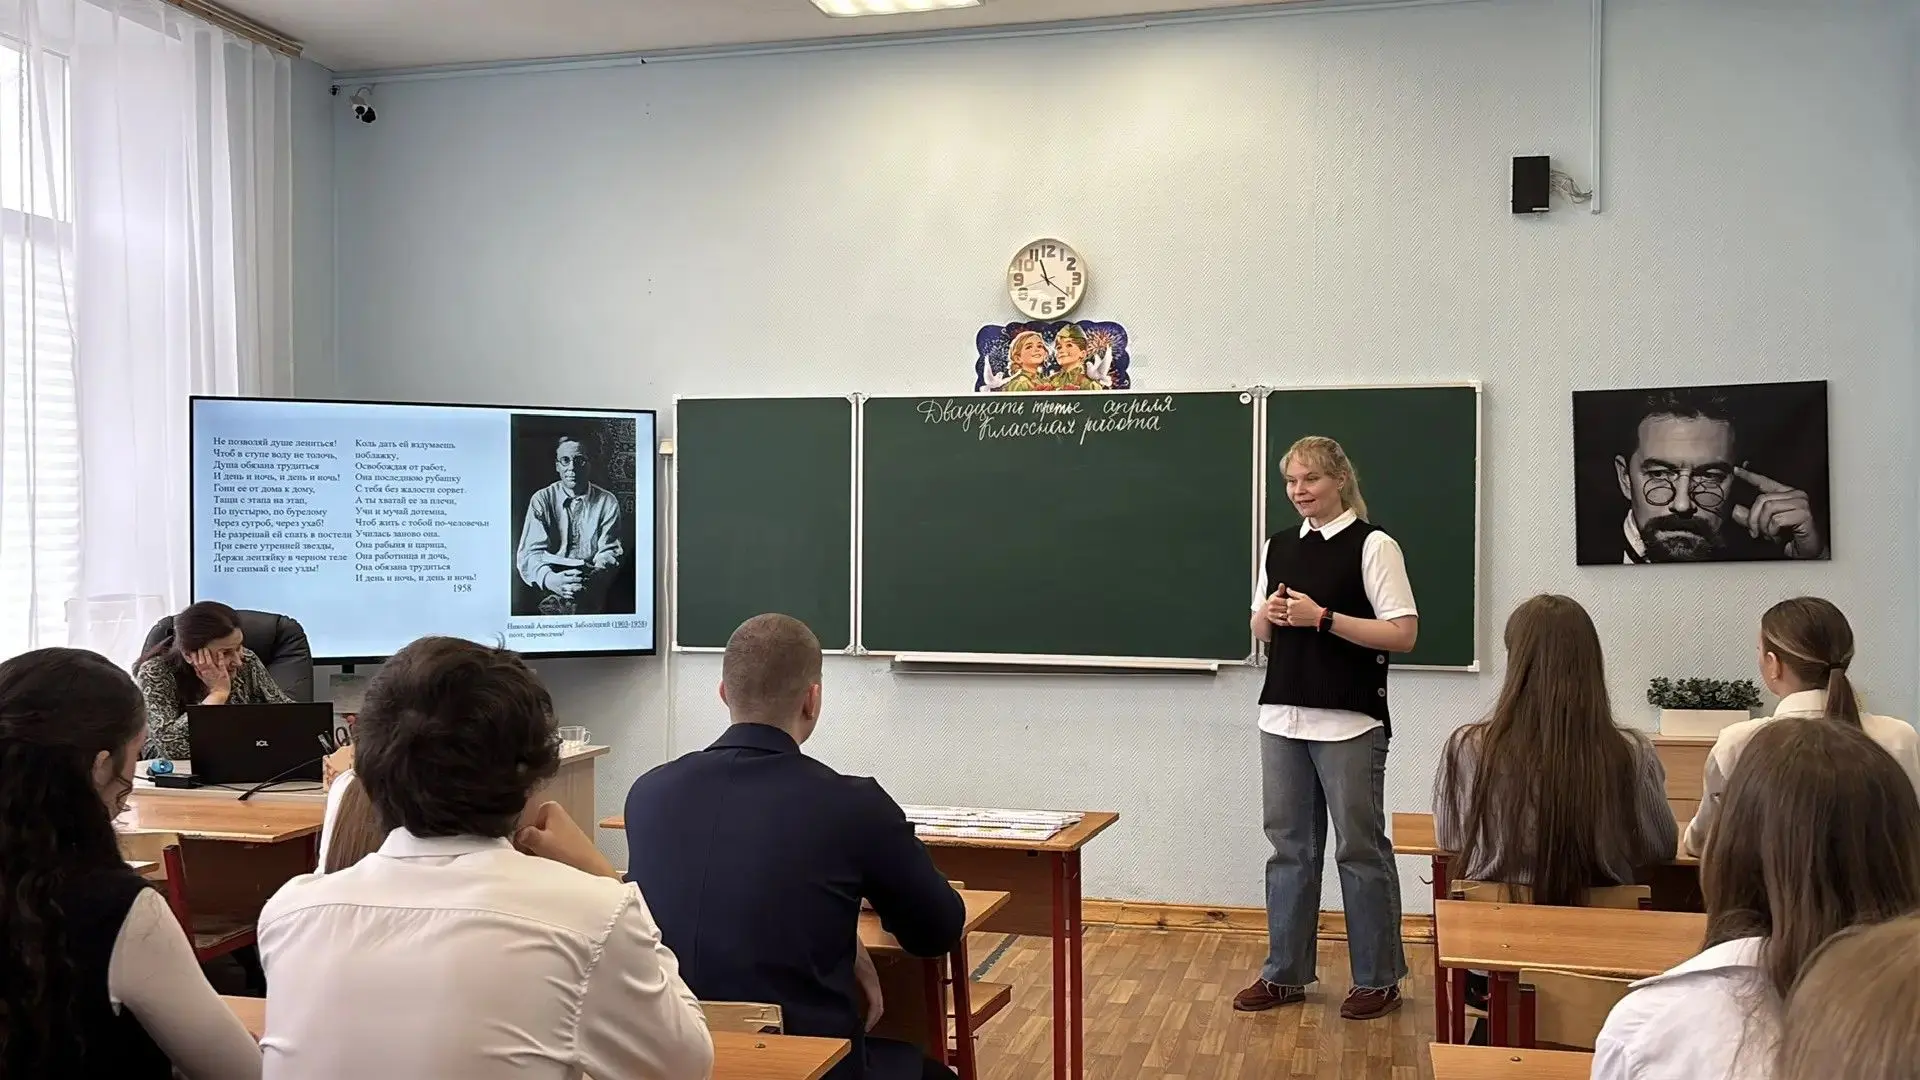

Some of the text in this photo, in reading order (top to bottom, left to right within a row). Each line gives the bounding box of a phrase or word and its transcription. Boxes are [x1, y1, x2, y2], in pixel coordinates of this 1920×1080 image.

[1030, 249, 1038, 262] 11
[1042, 245, 1056, 258] 12
[1060, 248, 1064, 261] 1
[1018, 259, 1034, 272] 10
[1066, 258, 1076, 270] 2
[1013, 273, 1024, 286] 9
[1072, 272, 1082, 285] 3
[1066, 287, 1076, 300] 4
[1030, 298, 1038, 310] 7
[1042, 301, 1052, 314] 6
[1056, 297, 1065, 310] 5
[917, 398, 1024, 432] Двадцать
[1103, 395, 1177, 422] апреля
[978, 413, 1161, 446] Классная работа
[213, 437, 337, 448] Не позволяй душе лениться!
[355, 439, 376, 447] Коль
[399, 440, 408, 448] ей
[411, 442, 455, 451] вздумаешь
[213, 449, 235, 457] Чтоб
[245, 452, 269, 460] ступе
[272, 452, 290, 461] воду
[306, 453, 337, 461] толочь,
[355, 451, 399, 462] поблажку,
[213, 461, 319, 472] Душа обязана трудиться
[355, 462, 406, 471] Освобождая
[421, 463, 446, 473] работ,
[318, 473, 340, 481] ночь!
[355, 473, 372, 481] Она
[426, 473, 461, 484] рубашку
[213, 484, 235, 492] Гони
[293, 487, 315, 495] дому,
[365, 484, 382, 492] тебя
[385, 484, 398, 492] без
[214, 496, 238, 505] Тащи
[286, 498, 307, 506] этап,
[378, 496, 406, 504] хватай
[229, 509, 271, 517] пустырю,
[286, 507, 327, 517] бурелому
[355, 507, 373, 515] Учи
[383, 507, 408, 517] мучай
[214, 519, 324, 529] Через сугроб, через ухаб!
[355, 518, 376, 526] Чтоб
[408, 518, 432, 526] тобой
[214, 530, 226, 538] Не
[229, 530, 269, 540] разрешай
[272, 530, 282, 538] ей
[355, 529, 391, 537] Училась
[214, 542, 232, 552] При
[260, 541, 300, 552] утренней
[355, 540, 372, 548] Она
[375, 540, 405, 550] рабыня
[416, 543, 447, 551] царица,
[214, 553, 243, 563] Держи
[246, 553, 286, 563] лентяйку
[296, 555, 326, 563] черном
[375, 551, 418, 562] работница
[237, 564, 268, 572] снимай
[296, 564, 318, 574] узды!
[355, 562, 451, 573] Она обязана трудиться
[455, 573, 476, 581] ночь!
